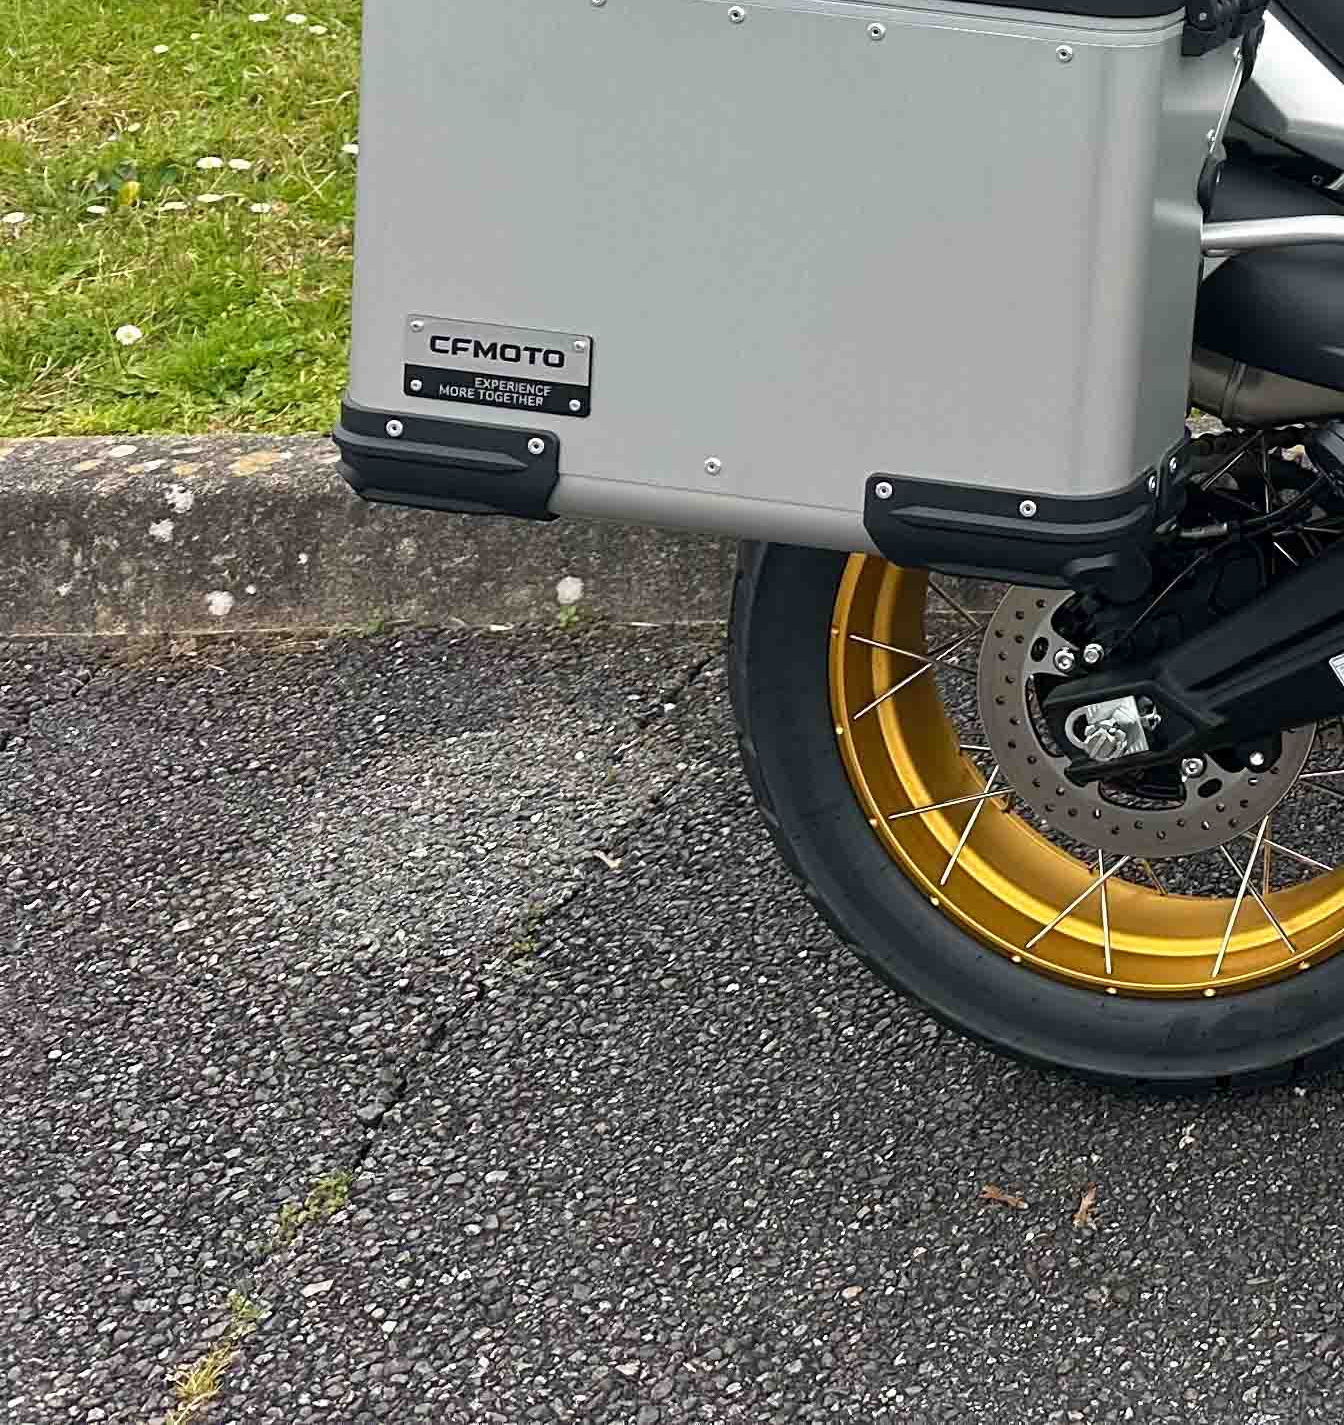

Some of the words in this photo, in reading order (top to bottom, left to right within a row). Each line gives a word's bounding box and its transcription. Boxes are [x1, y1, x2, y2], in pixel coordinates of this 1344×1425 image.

[429, 335, 566, 368] CFMOTO
[438, 384, 475, 400] MORE
[477, 389, 544, 408] TOGETHER
[474, 377, 552, 397] EXPERIENCE
